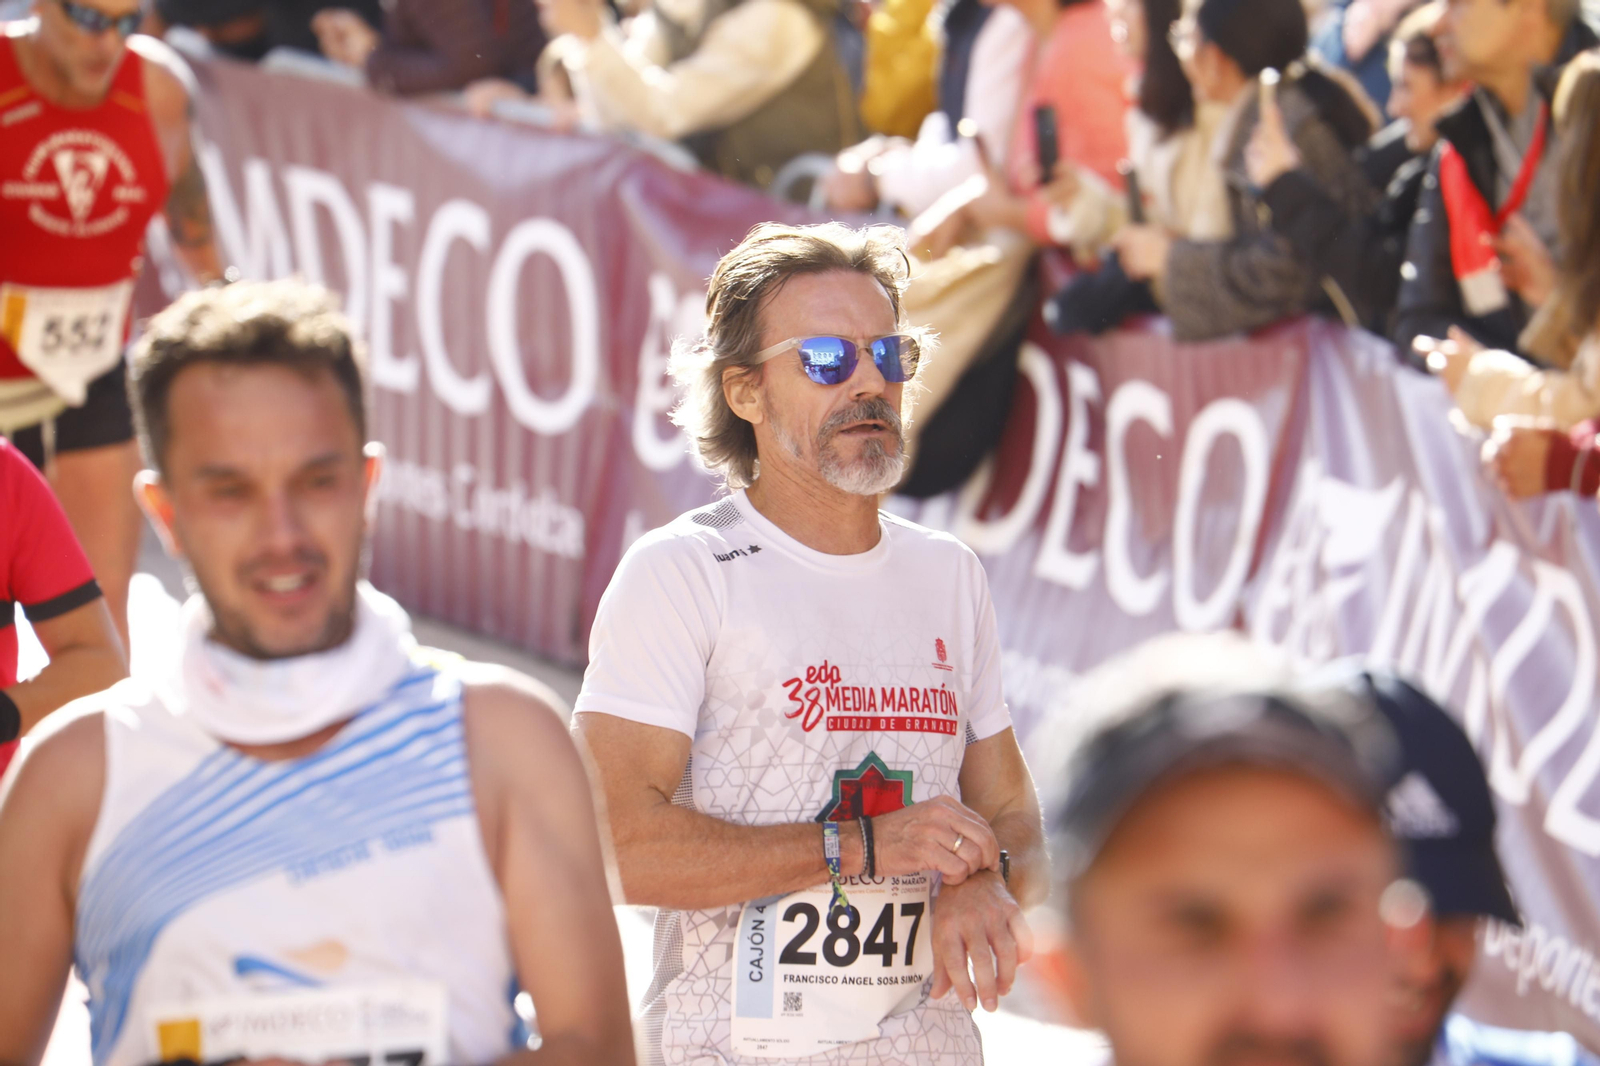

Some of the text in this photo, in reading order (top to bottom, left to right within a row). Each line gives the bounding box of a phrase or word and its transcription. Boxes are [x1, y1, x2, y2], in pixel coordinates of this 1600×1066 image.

[805, 659, 842, 690] edp
[782, 677, 959, 733] 38 MEDIA MARATÓN
[827, 717, 956, 734] CIUDAD DE GRANADA
[746, 919, 765, 982] CAJÓN
[778, 901, 925, 968] 2847
[783, 973, 923, 986] FRANCISCO ÁNGEL SOSA SIMÓN
